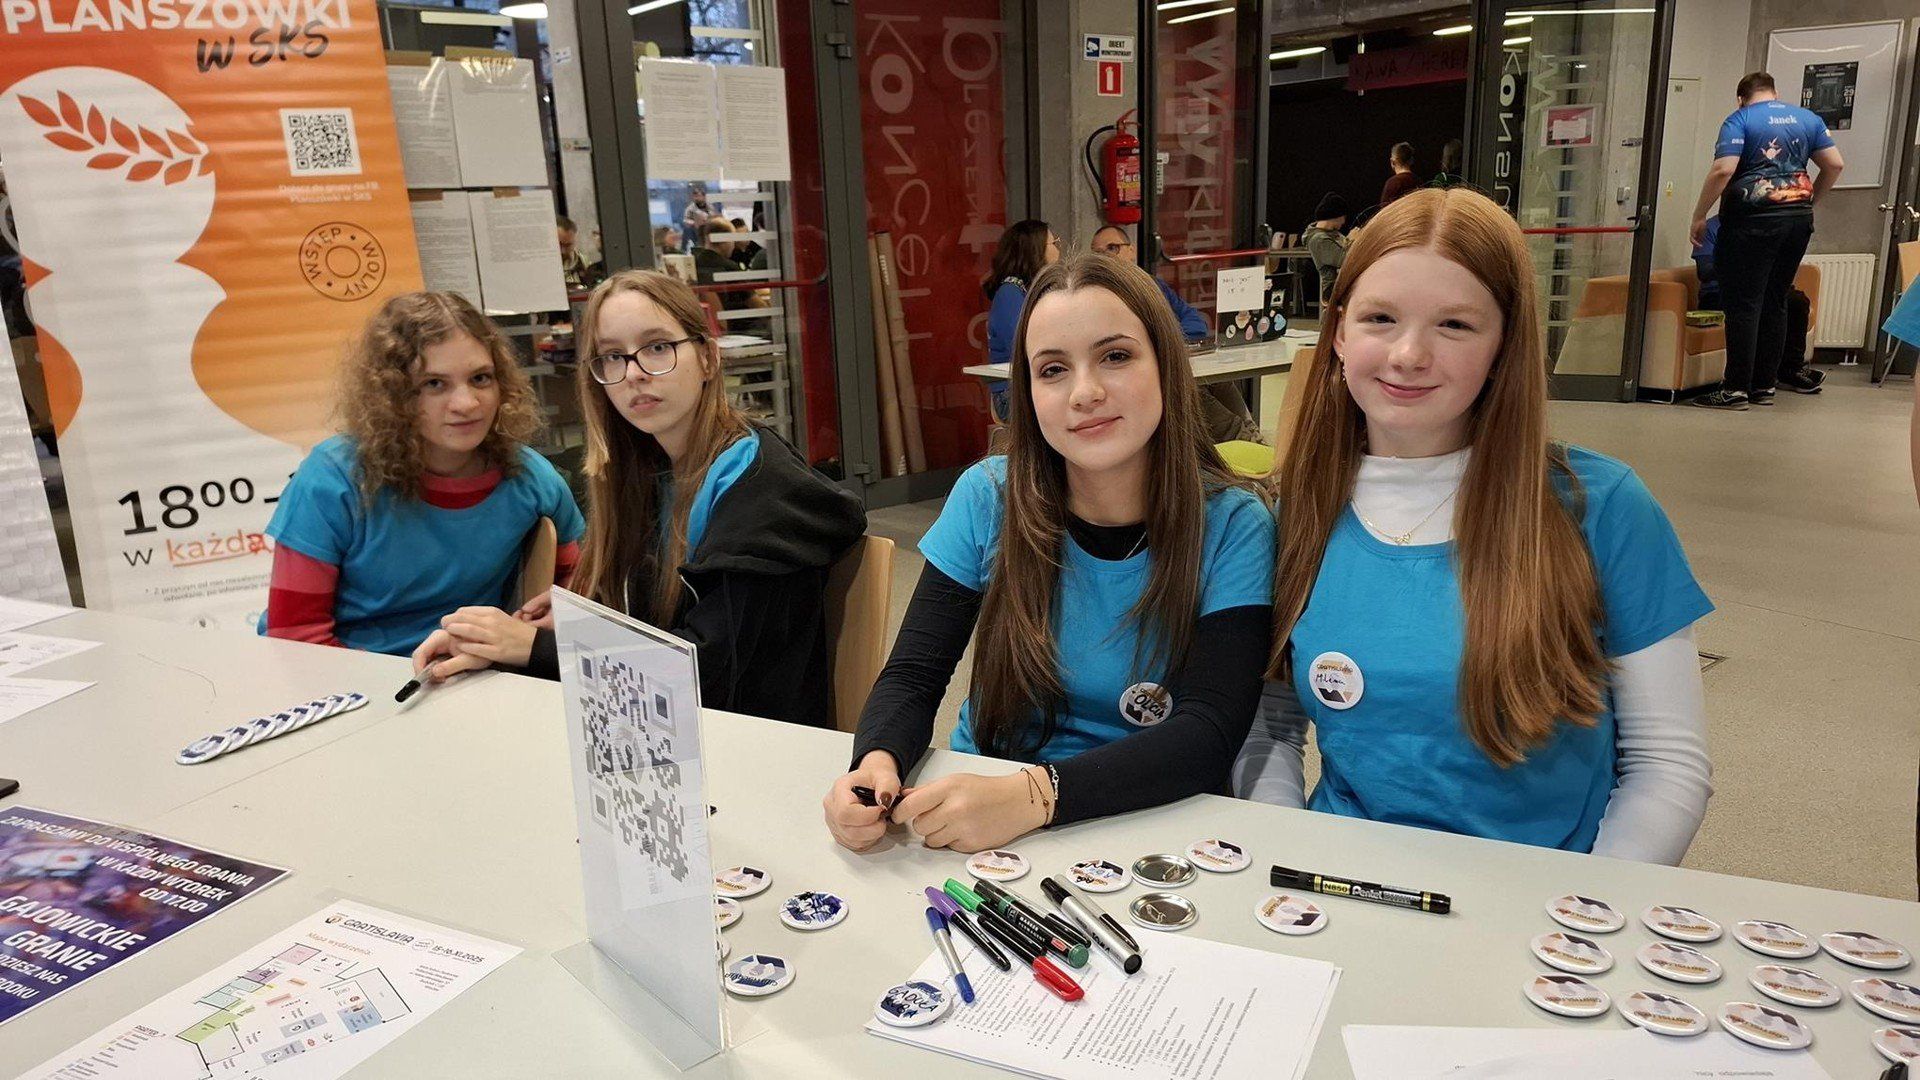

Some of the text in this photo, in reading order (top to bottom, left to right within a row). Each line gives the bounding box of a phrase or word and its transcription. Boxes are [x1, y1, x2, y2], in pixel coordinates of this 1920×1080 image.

[249, 20, 329, 66] SKS
[1768, 114, 1797, 125] Janek
[344, 241, 380, 296] WOLNY
[0, 816, 255, 887] ZAPRASZAMY DO WSPÓLNEGO GRANIA
[96, 856, 233, 901] W KAŻDY WTOREK
[1323, 883, 1348, 892] N850
[1352, 885, 1383, 899] Pentel
[138, 887, 209, 913] OD 17.00
[0, 895, 147, 951] GAJOWICKIE
[343, 919, 415, 944] GRATISLAVIA
[3, 930, 109, 972] GRANIE
[34, 969, 69, 985] NAS
